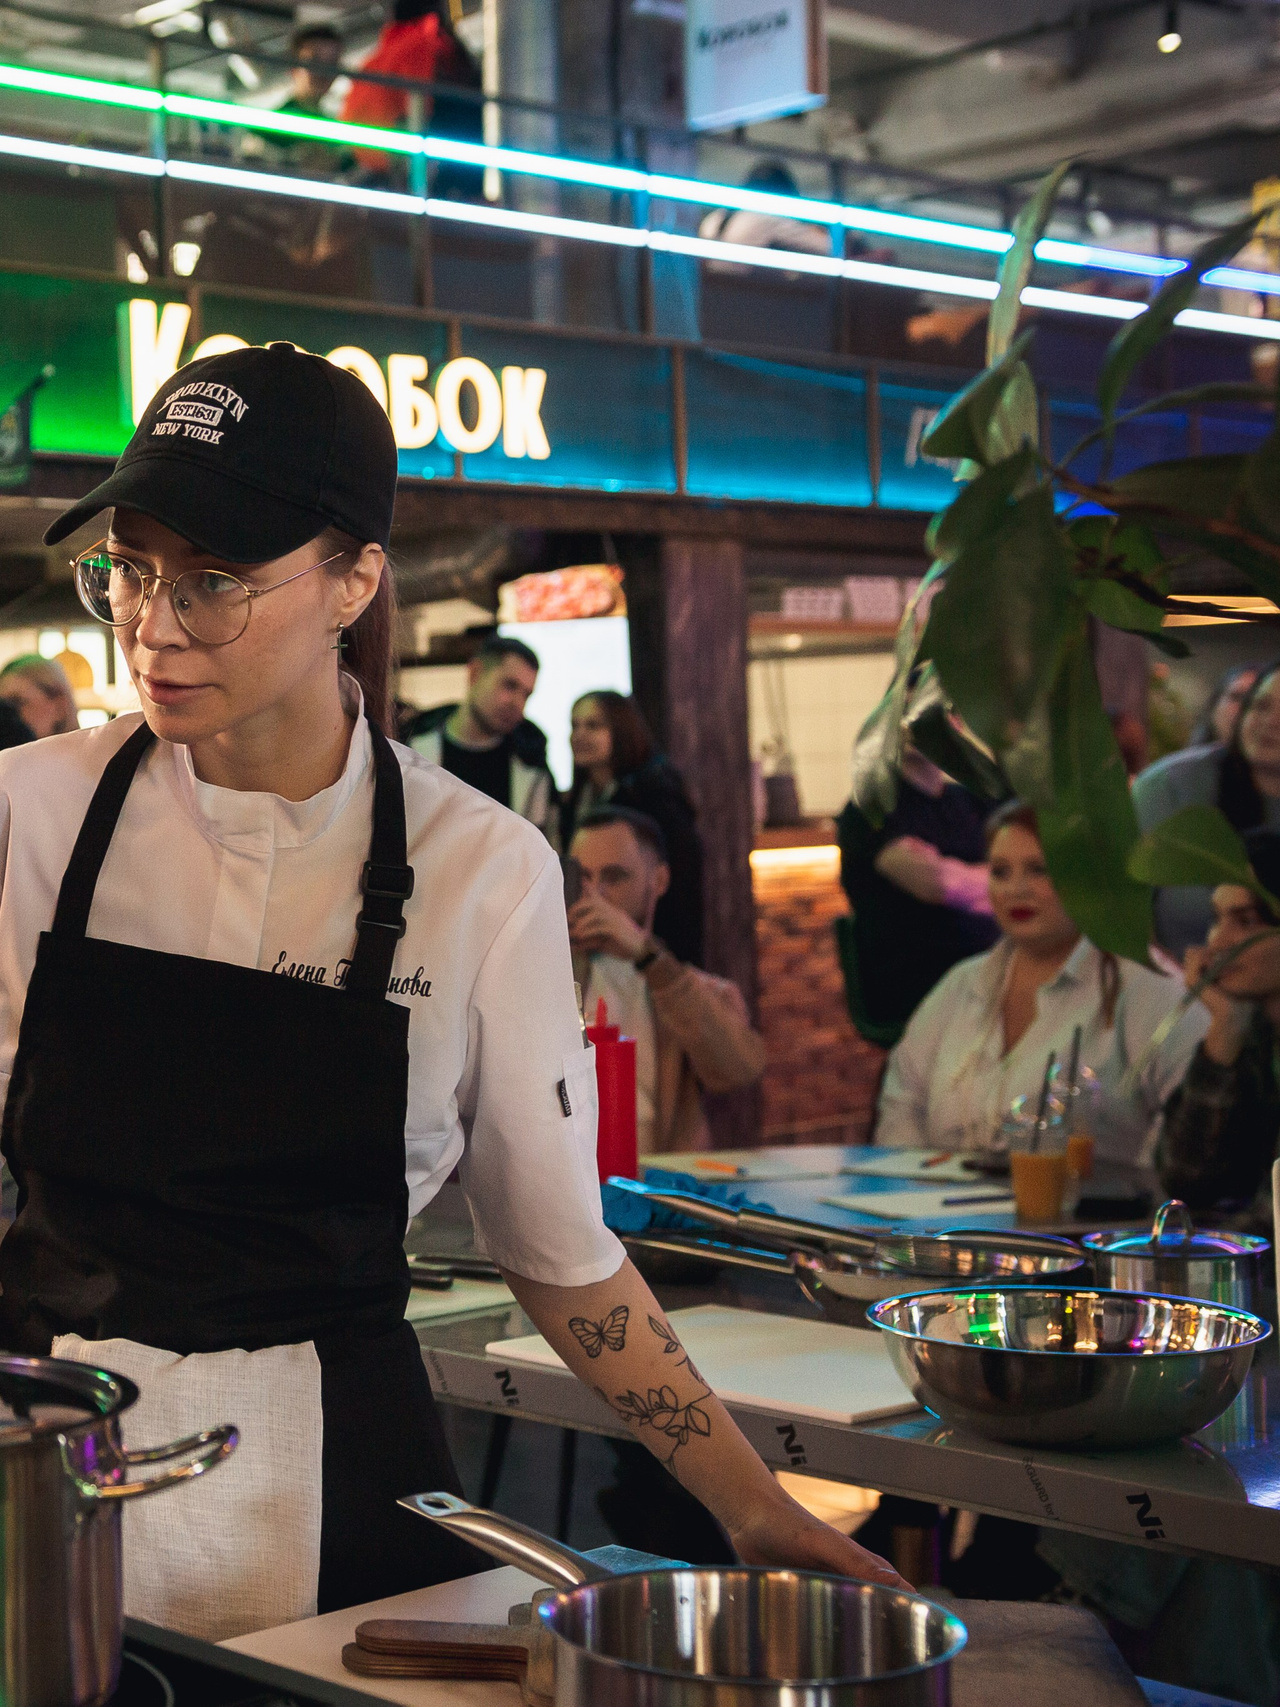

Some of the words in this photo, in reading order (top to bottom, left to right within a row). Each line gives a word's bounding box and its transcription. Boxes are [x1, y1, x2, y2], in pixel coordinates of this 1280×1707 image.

[156, 382, 249, 422] BROOKLYN
[151, 422, 182, 436] NEW
[182, 423, 224, 445] YORK
[1126, 1491, 1166, 1540] Ni
